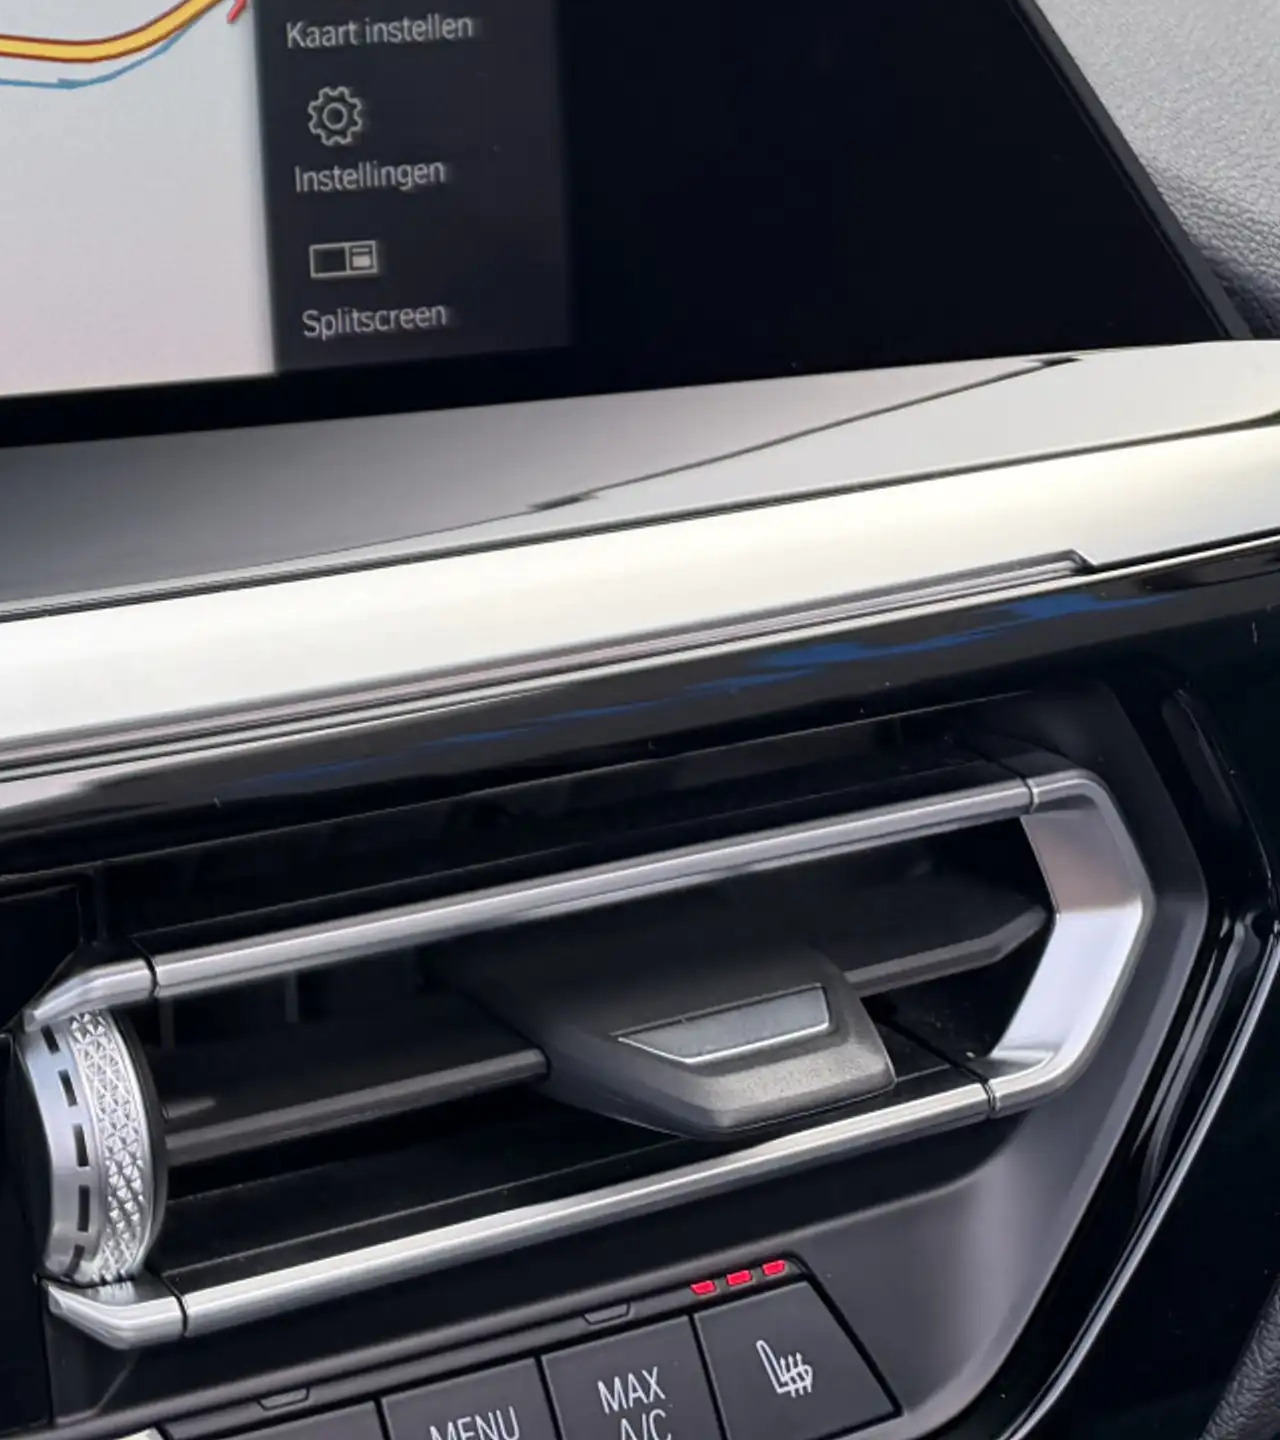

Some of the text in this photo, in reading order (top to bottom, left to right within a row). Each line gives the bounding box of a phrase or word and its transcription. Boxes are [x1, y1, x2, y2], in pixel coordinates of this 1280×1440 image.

[285, 14, 475, 49] Kaart instellen
[294, 161, 446, 193] Instellingen
[302, 303, 448, 340] Splitscreen
[597, 1366, 666, 1414] MAX
